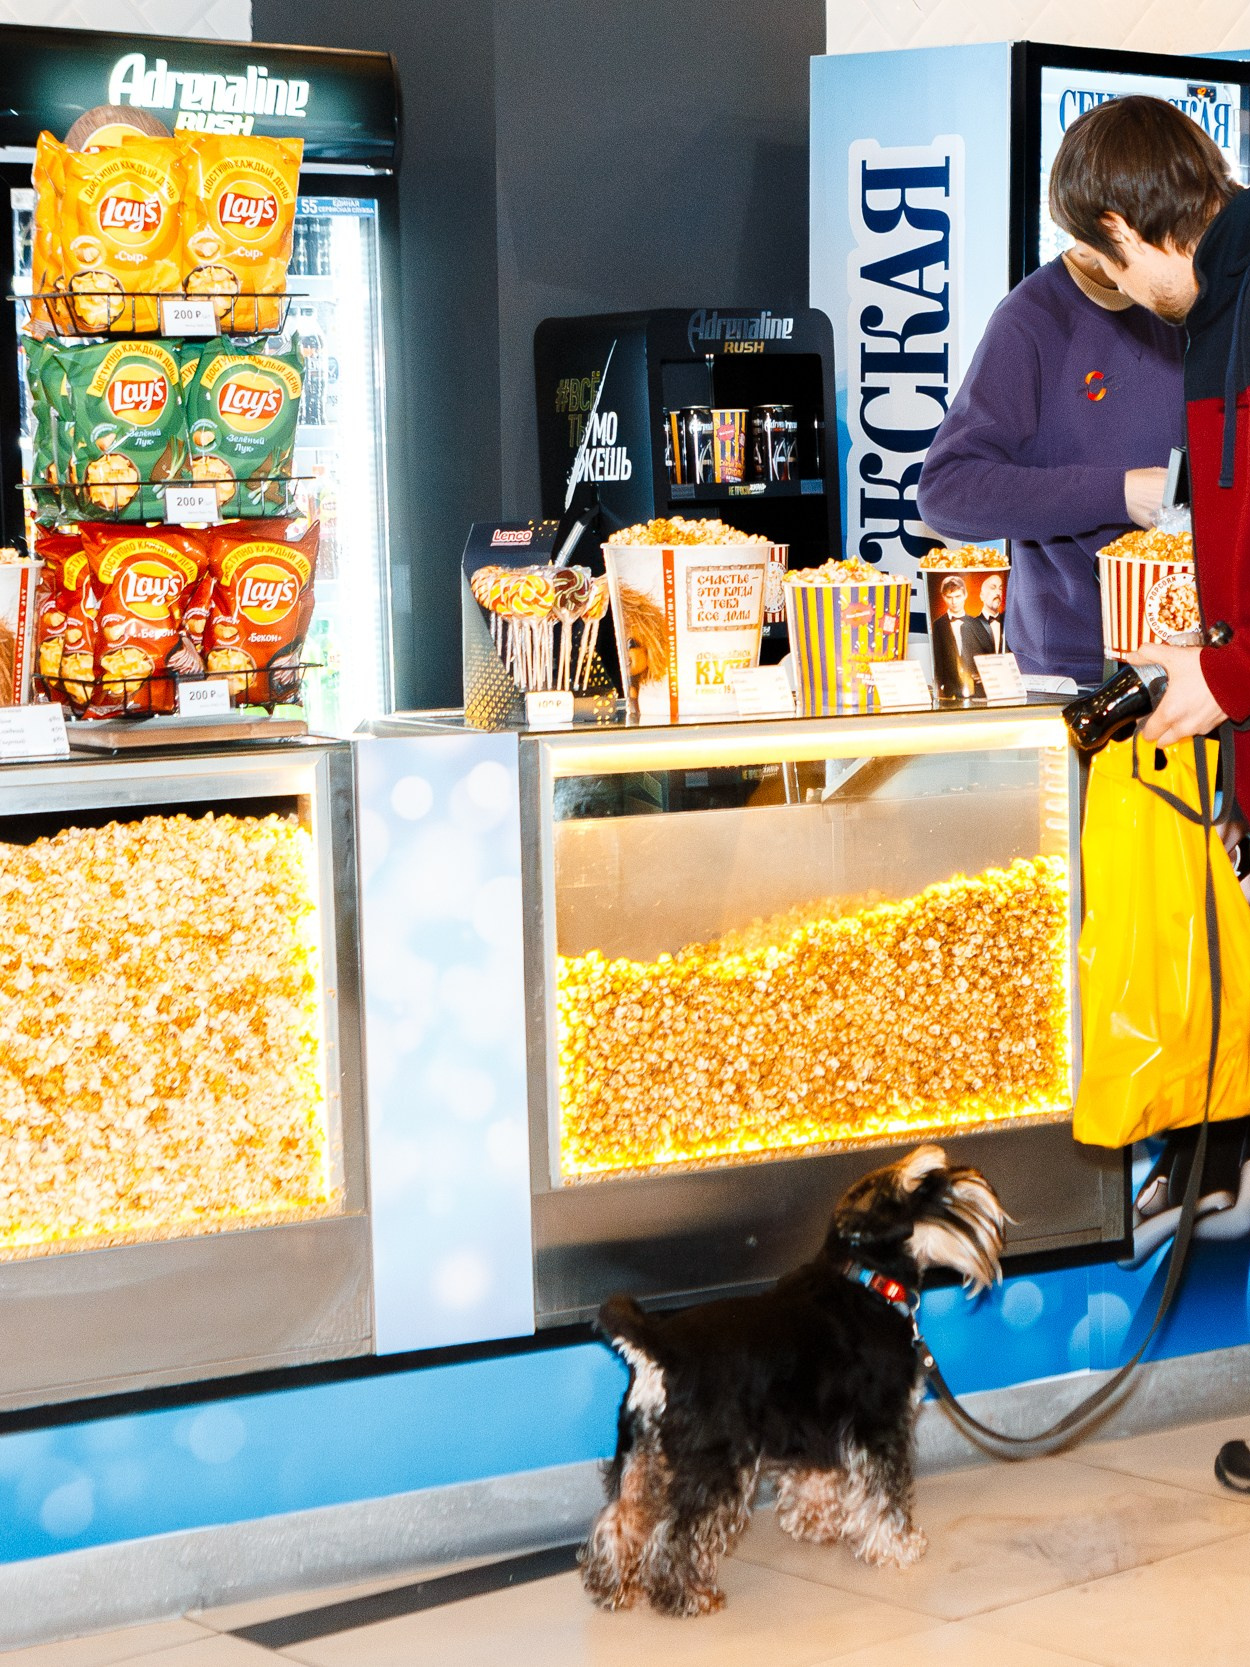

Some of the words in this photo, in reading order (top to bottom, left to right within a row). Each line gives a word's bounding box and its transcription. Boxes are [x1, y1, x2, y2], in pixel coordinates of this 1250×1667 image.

[109, 53, 310, 117] Adrenaline
[176, 111, 254, 136] RUSH
[120, 161, 157, 184] КАЖДЫЙ
[203, 160, 235, 195] ДОСТУПНО
[234, 159, 274, 177] КАЖДЫЙ
[273, 174, 290, 200] ДЕНЬ
[102, 193, 160, 232] Lay's
[221, 193, 275, 228] Lay's
[301, 199, 318, 214] 55
[174, 309, 193, 320] 200
[688, 309, 794, 352] Adrenaline
[724, 341, 765, 353] RUSH
[95, 349, 122, 393] ДОСТУПНО
[121, 344, 163, 360] КАЖДЫЙ
[284, 369, 299, 394] ДЕНЬ
[113, 378, 164, 412] Lay's
[221, 384, 280, 419] Lay's
[176, 497, 195, 507] 200
[492, 529, 533, 542] Lenco
[102, 542, 136, 577] ДОСТУПНО
[255, 545, 296, 561] КАЖДЫЙ
[125, 571, 182, 607] Lay's
[697, 574, 749, 585] СЧАСТЬЕ
[697, 587, 721, 597] ЭТО
[723, 585, 753, 597] КОГДА
[1149, 576, 1177, 601] POPCORN
[241, 578, 295, 611] Lay's
[697, 611, 720, 622] ВСЕ
[723, 610, 751, 622] ДОМА
[189, 690, 208, 701] 200
